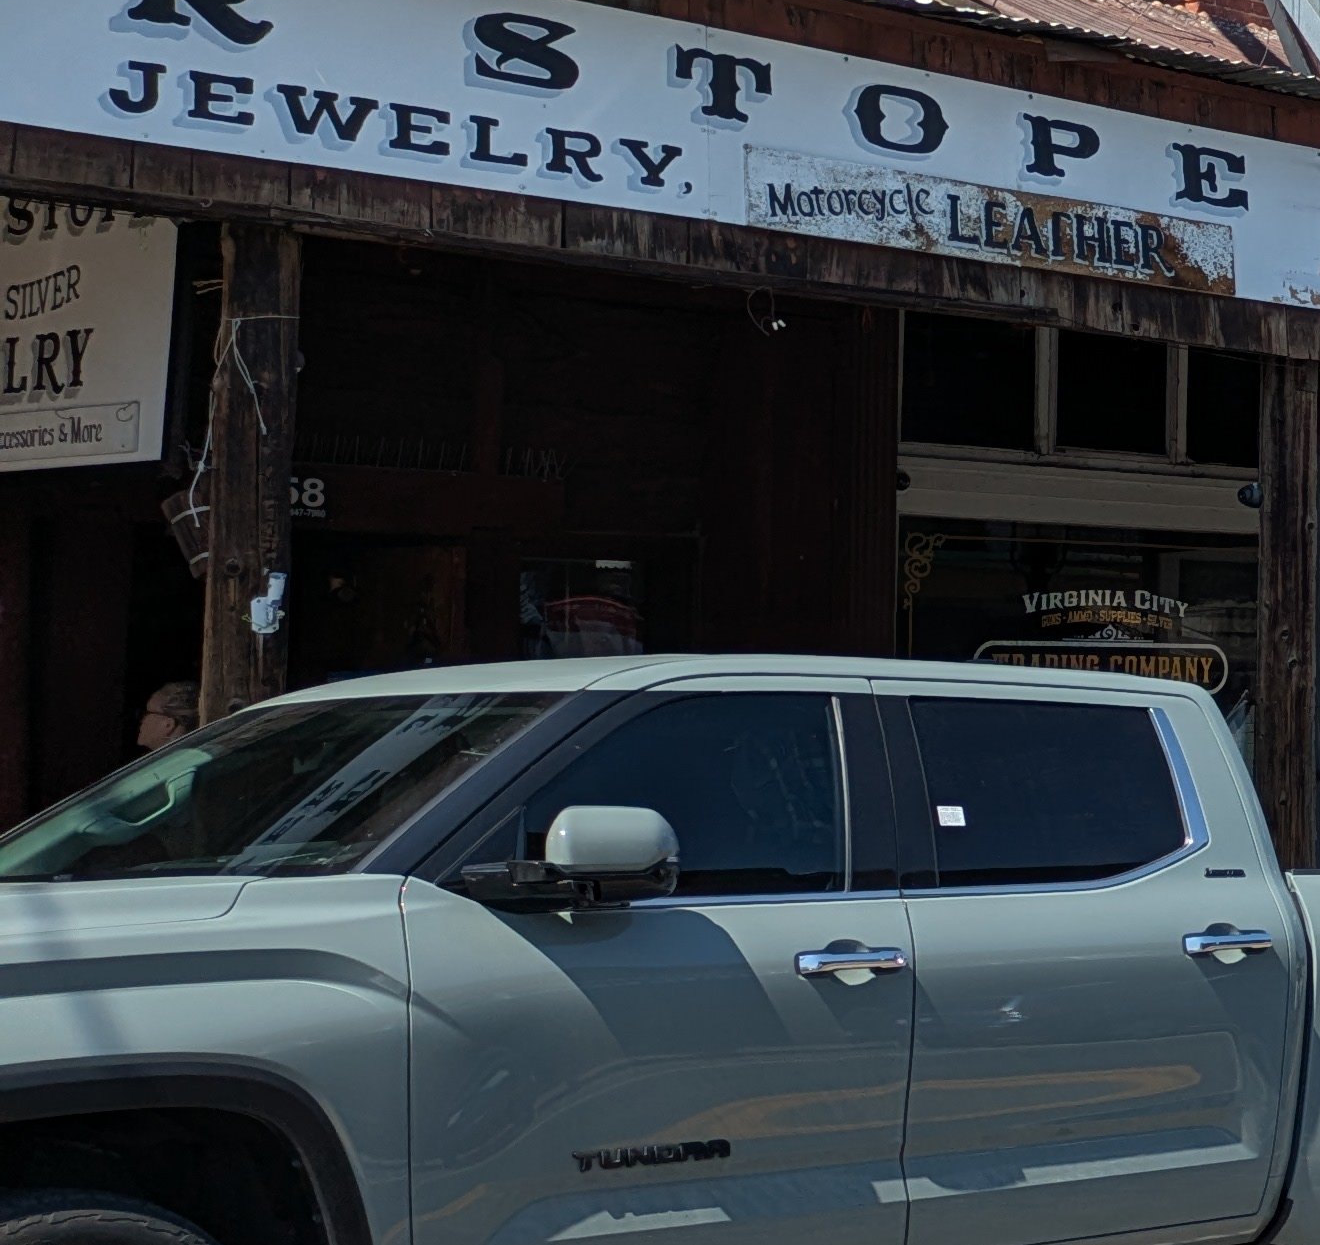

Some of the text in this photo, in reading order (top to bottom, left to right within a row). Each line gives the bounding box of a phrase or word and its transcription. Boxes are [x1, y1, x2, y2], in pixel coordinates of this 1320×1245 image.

[105, 60, 693, 196] JEWELRY,
[766, 182, 936, 223] Motorcycle
[5, 264, 81, 321] SILVER
[71, 416, 102, 444] More
[1022, 589, 1189, 618] VIRGINIA CITY
[572, 1138, 731, 1172] TUNDRA
